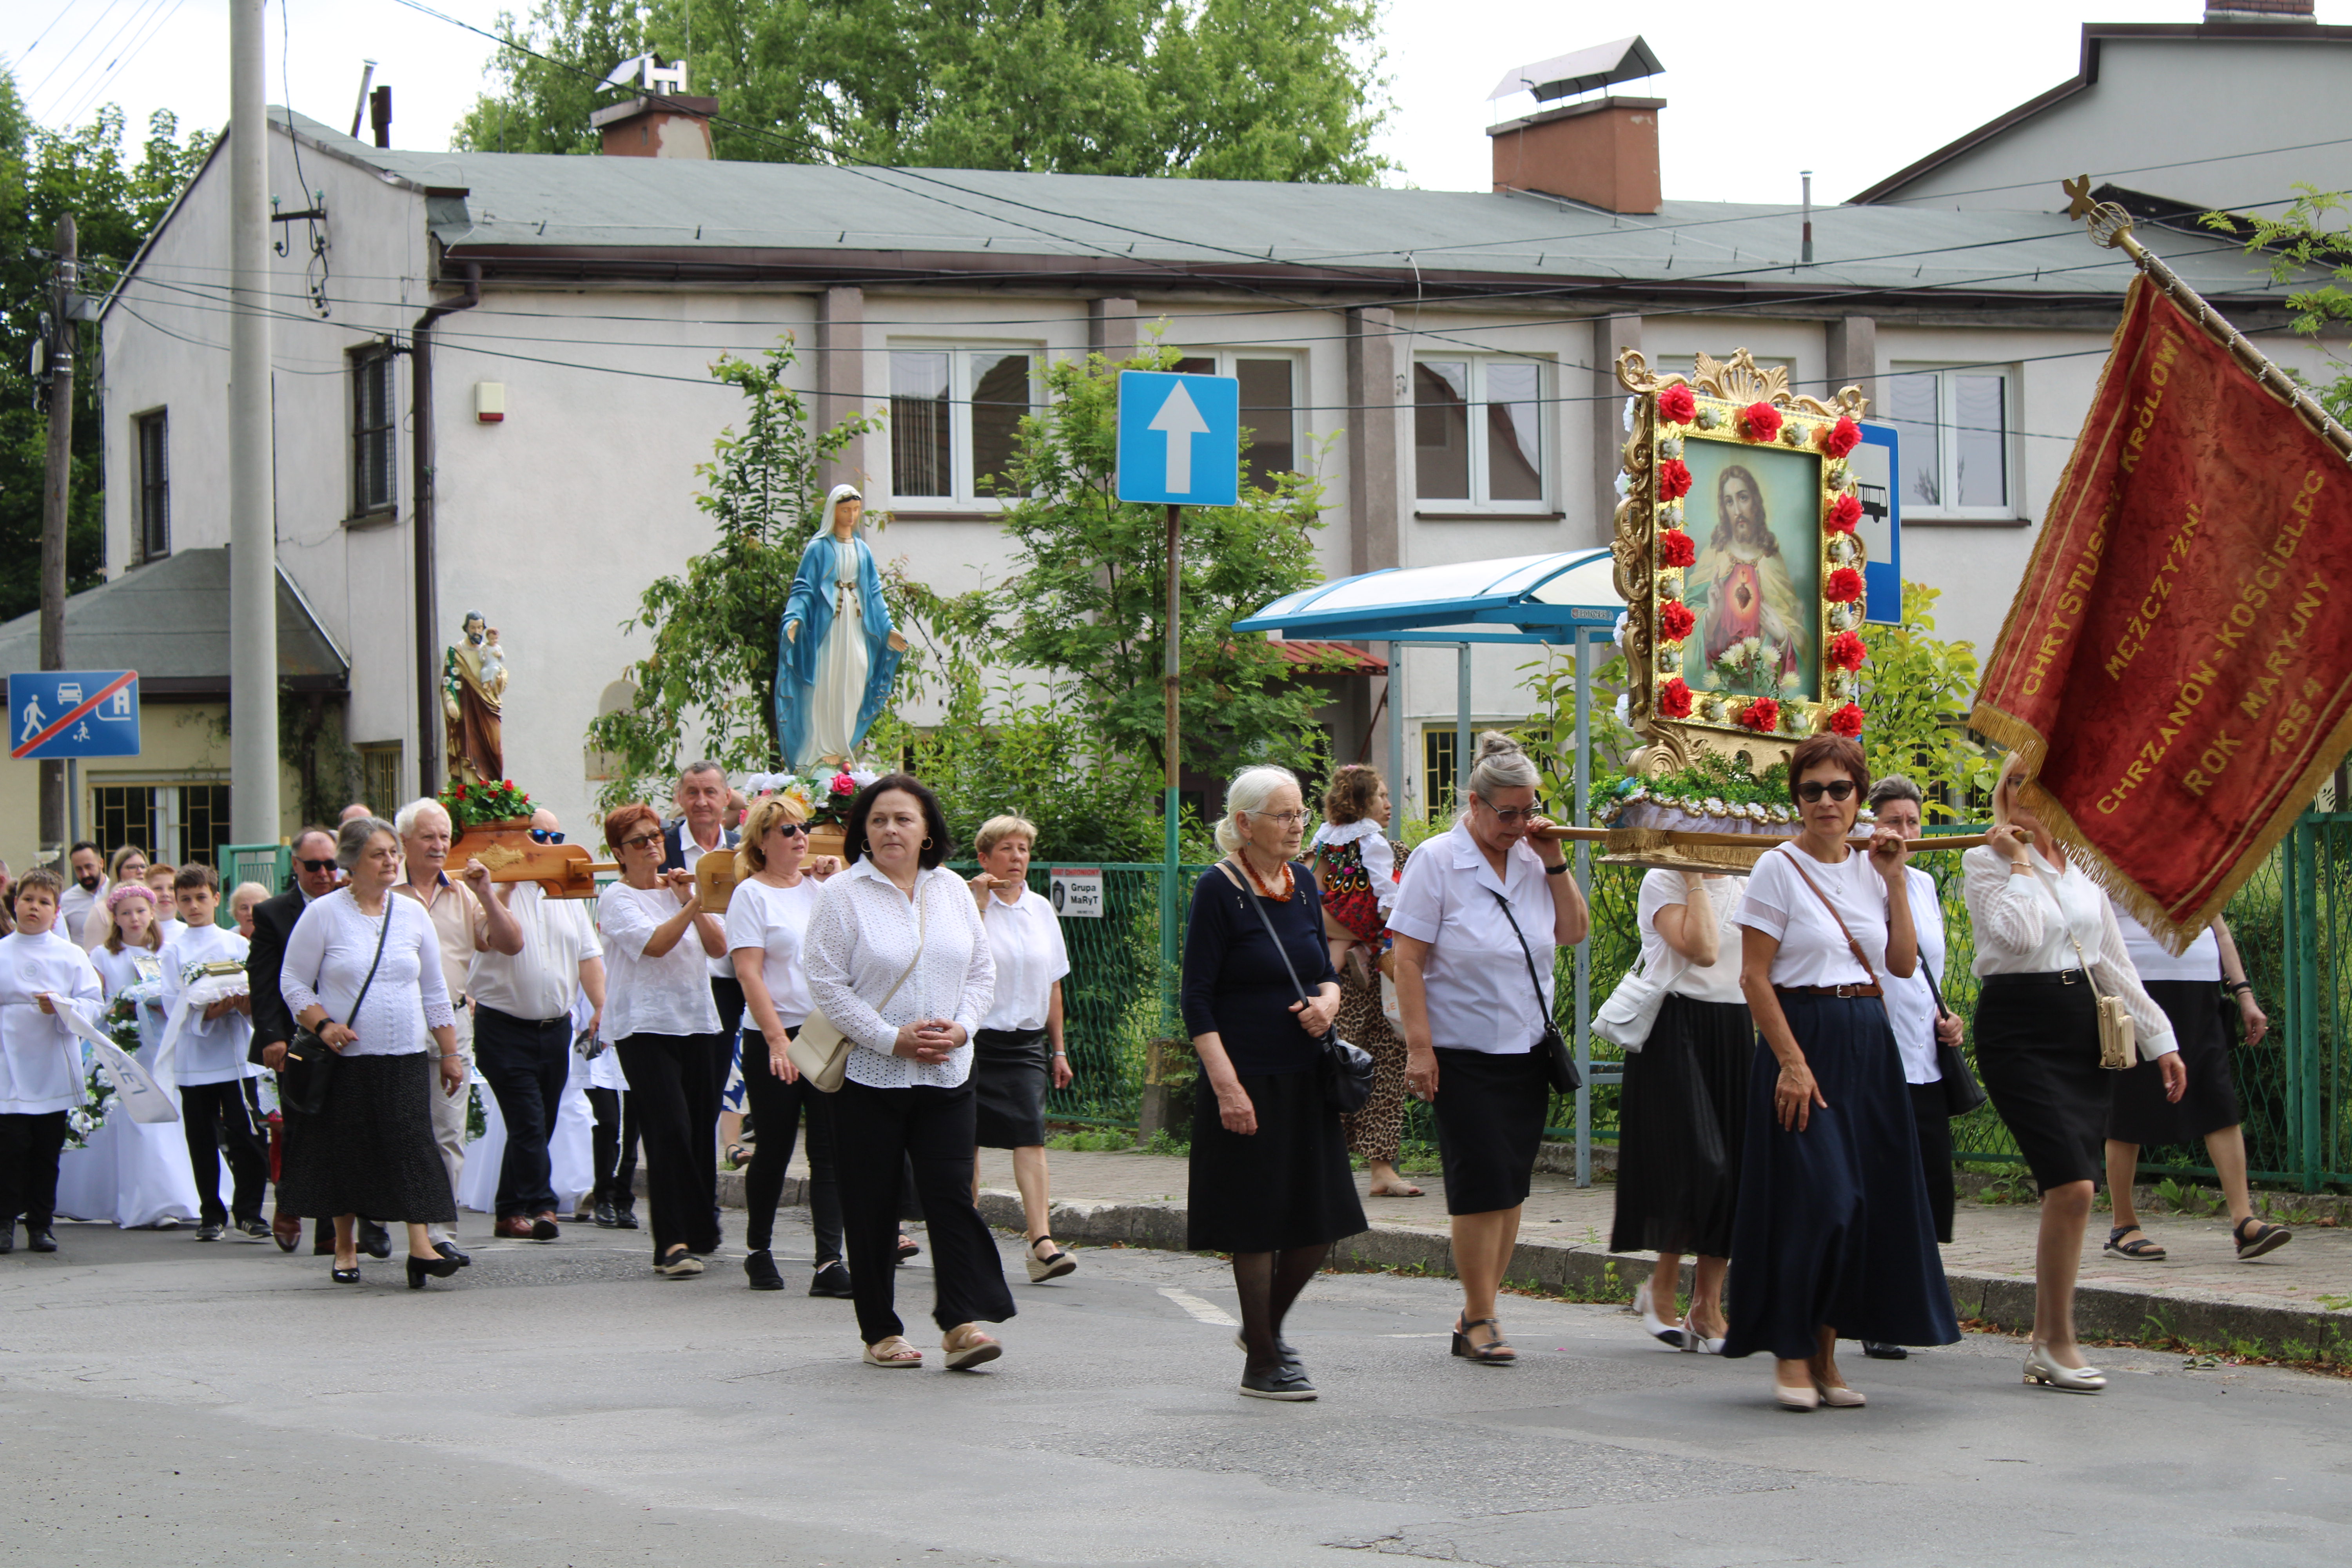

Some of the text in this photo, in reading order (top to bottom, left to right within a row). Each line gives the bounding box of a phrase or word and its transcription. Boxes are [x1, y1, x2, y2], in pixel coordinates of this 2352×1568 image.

[2023, 481, 2121, 696] CHRYSTUSOI
[2183, 572, 2330, 796] ROK MARYJNY
[2270, 677, 2323, 756] 1954
[1071, 883, 1096, 893] Grupa
[1071, 896, 1098, 906] MaRyT
